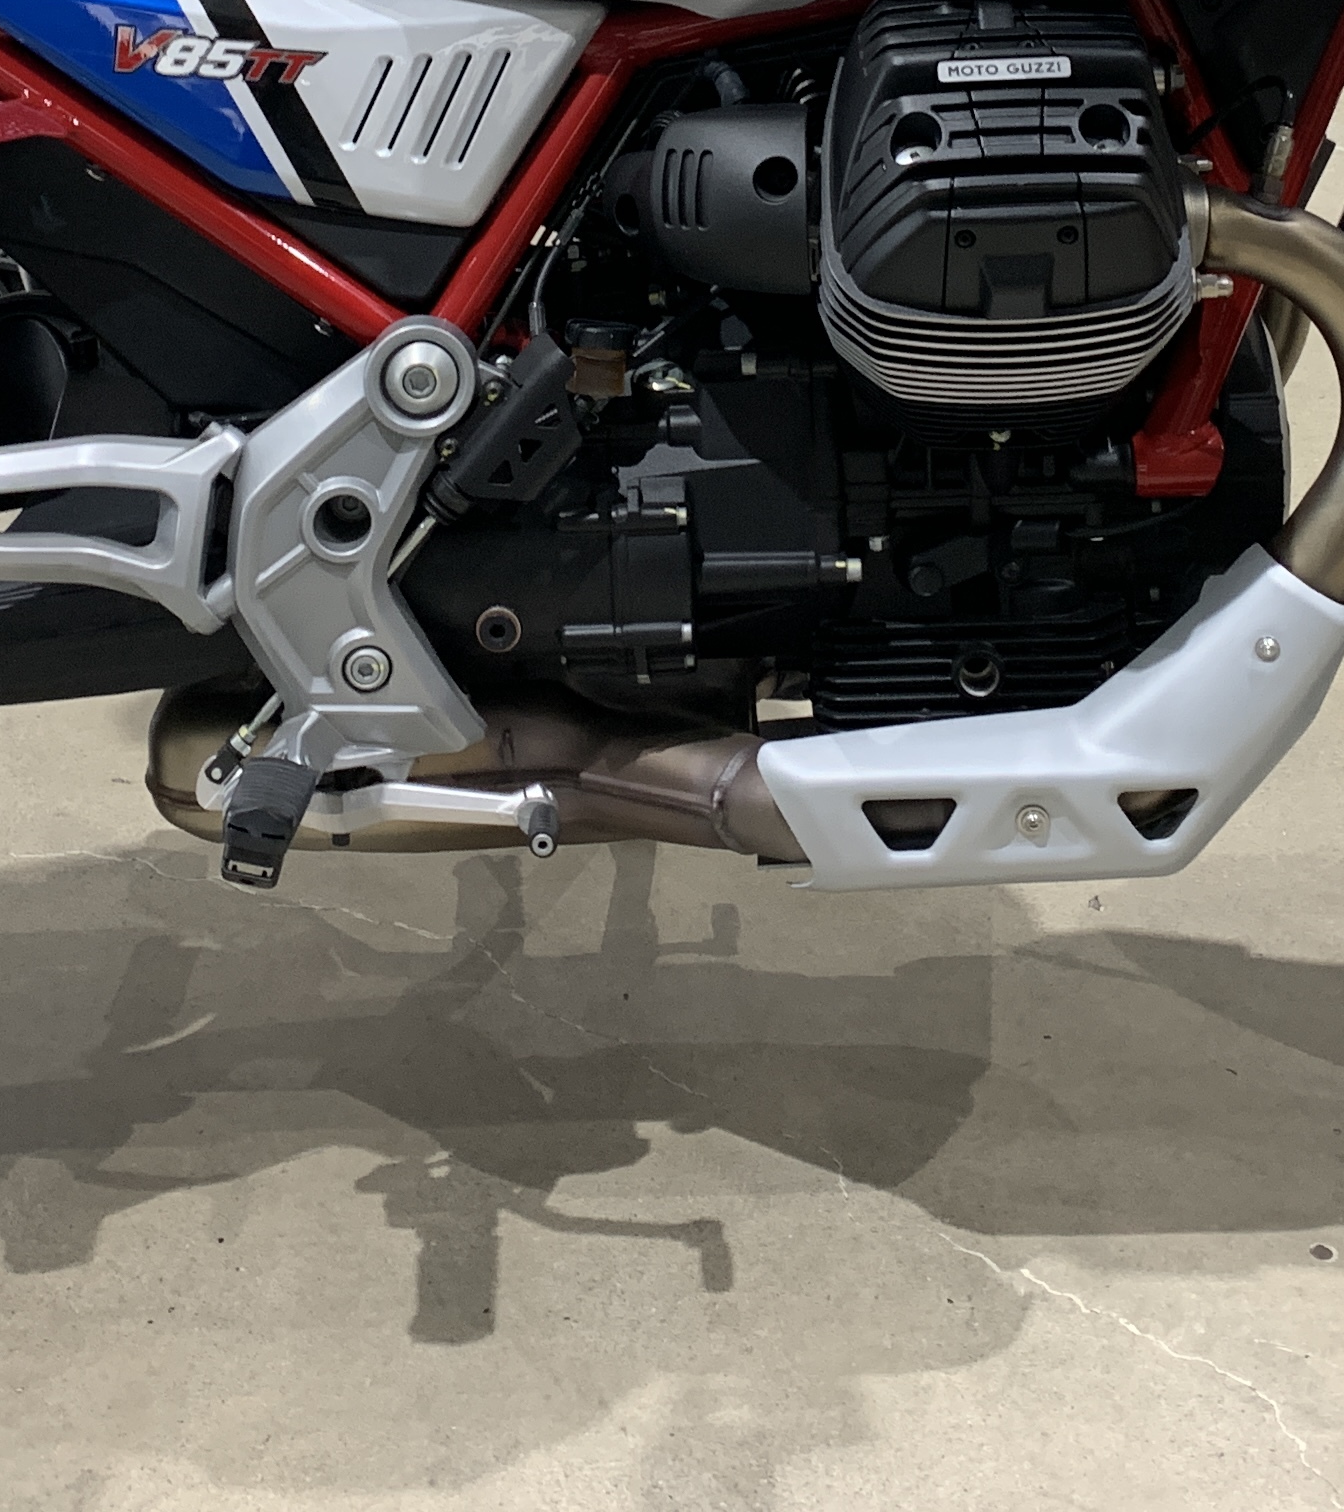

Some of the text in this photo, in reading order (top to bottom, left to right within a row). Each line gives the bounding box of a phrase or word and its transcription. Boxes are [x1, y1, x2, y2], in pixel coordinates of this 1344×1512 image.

[113, 24, 329, 85] V85TT
[948, 61, 1062, 77] MOTO GUZZI
